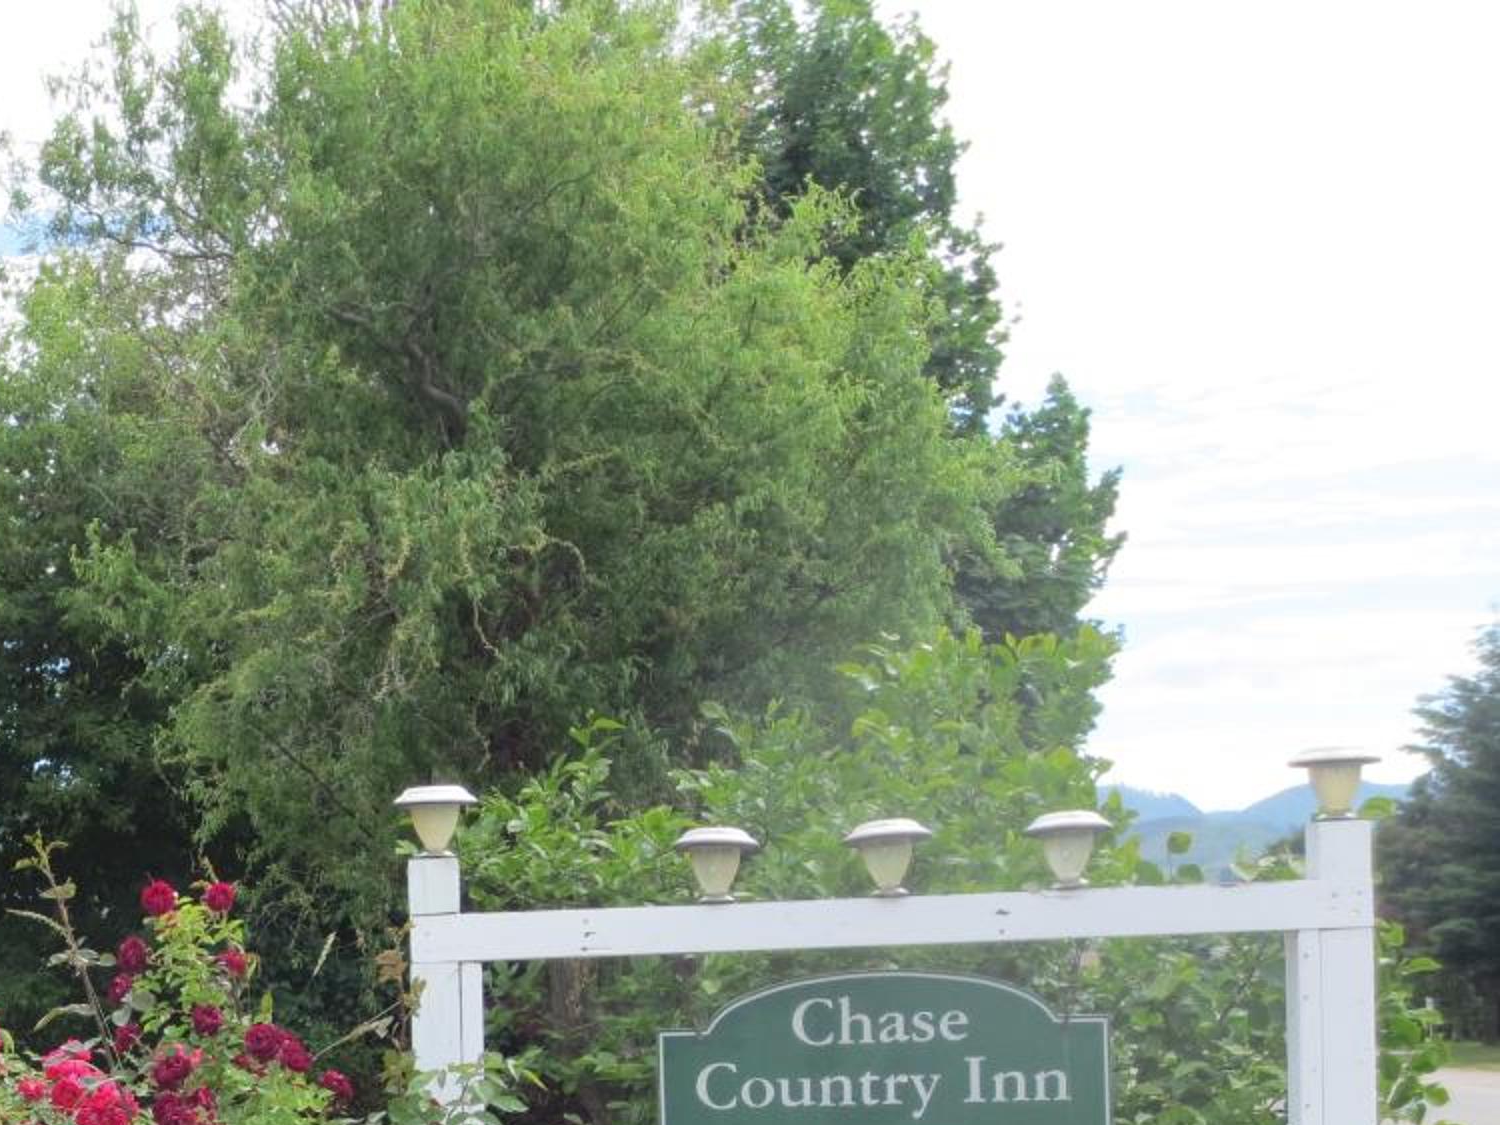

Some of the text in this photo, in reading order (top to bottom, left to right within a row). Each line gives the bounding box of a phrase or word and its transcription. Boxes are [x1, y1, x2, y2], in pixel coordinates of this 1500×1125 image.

[792, 995, 970, 1047] Chase
[695, 1056, 1071, 1119] Country Inn
